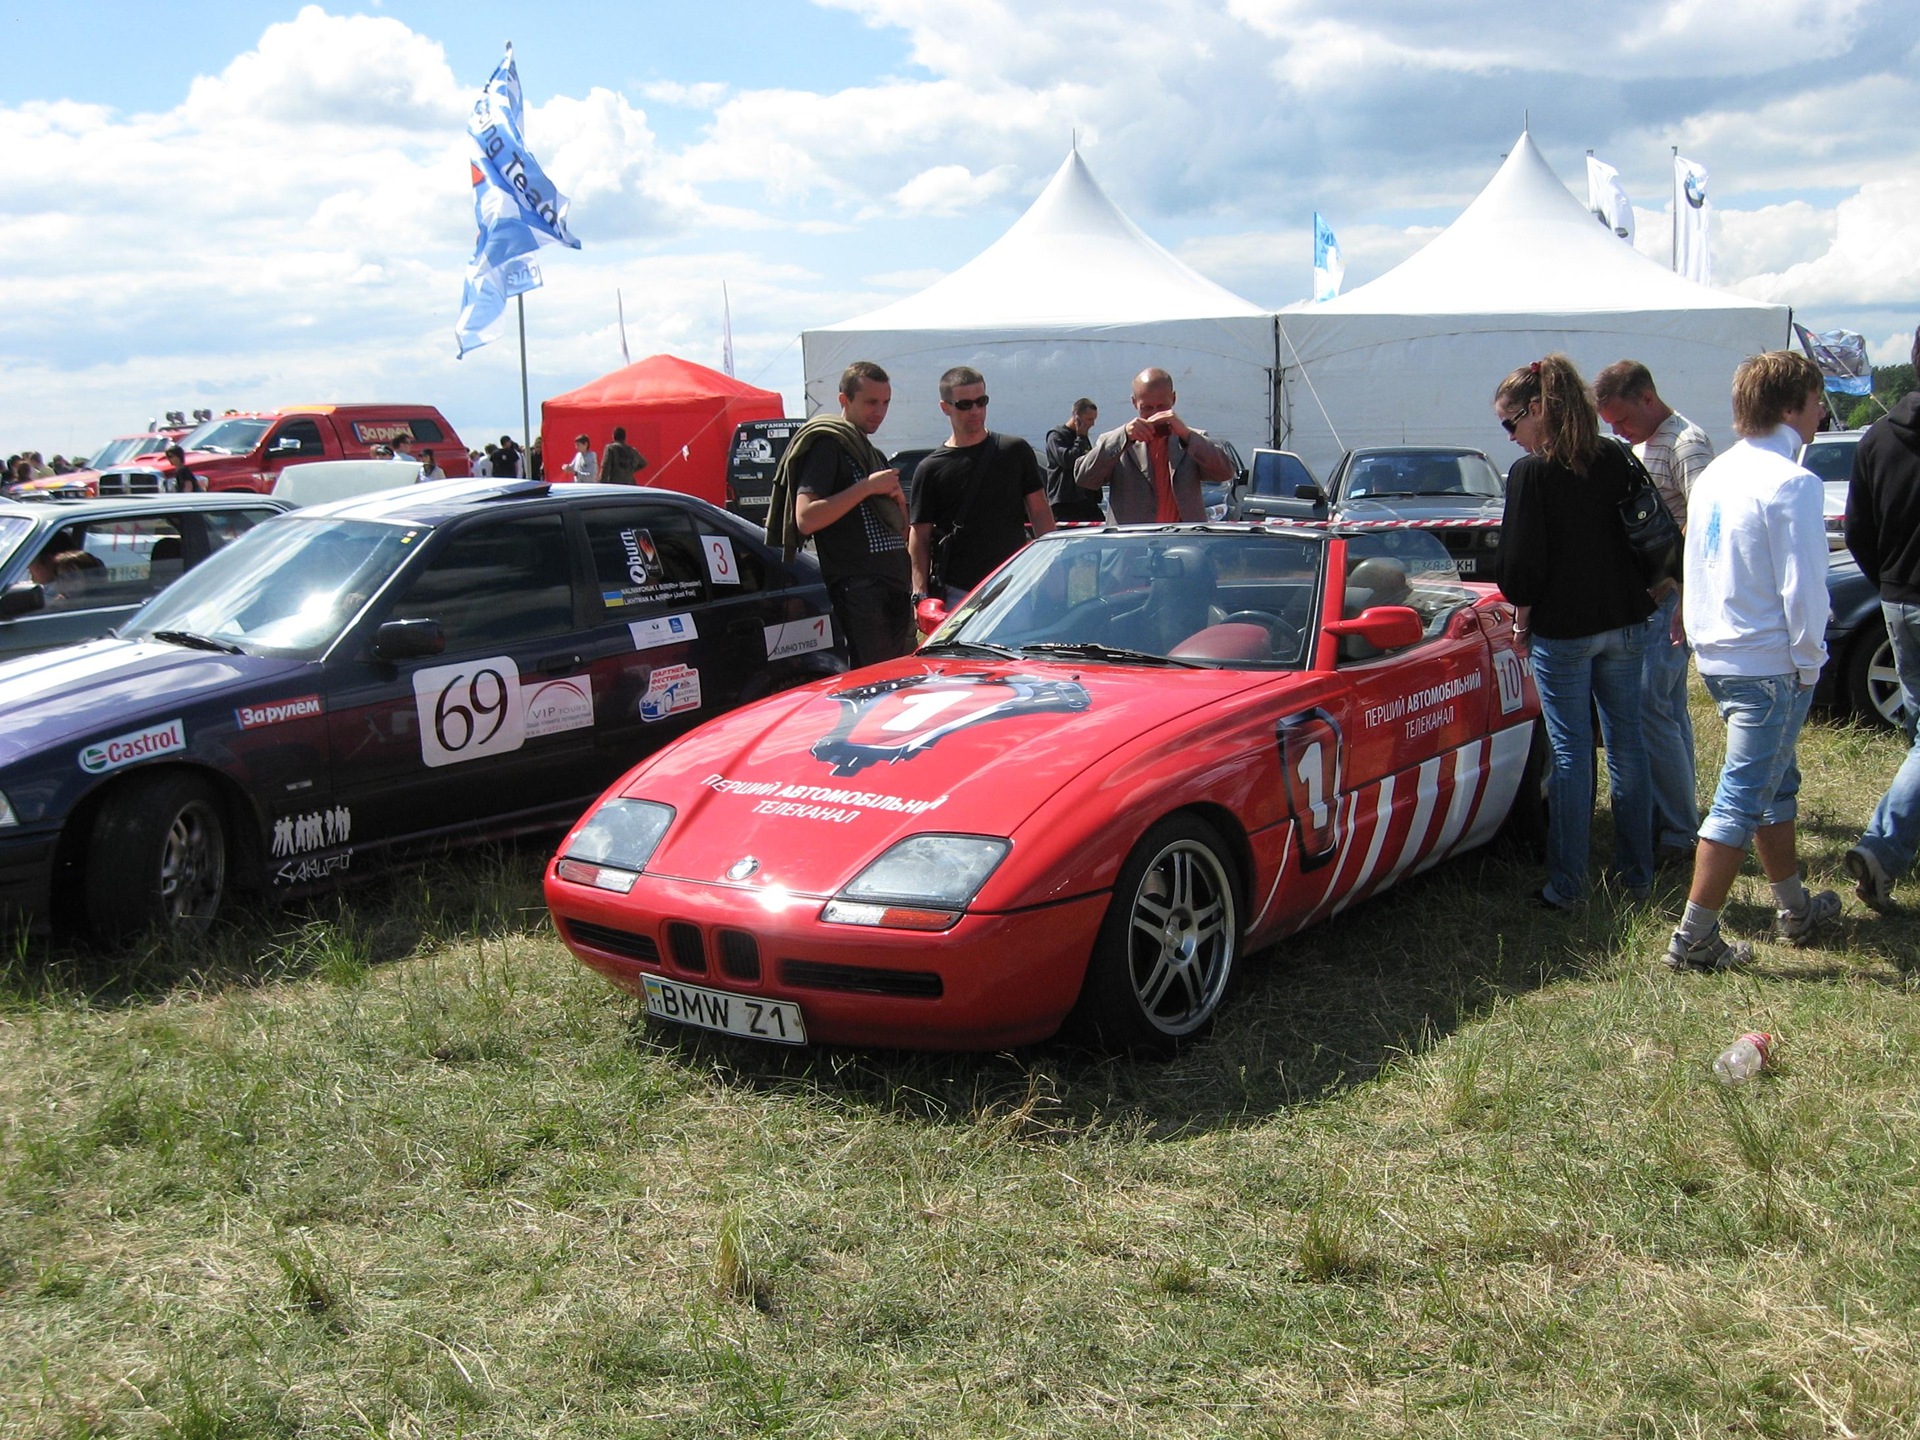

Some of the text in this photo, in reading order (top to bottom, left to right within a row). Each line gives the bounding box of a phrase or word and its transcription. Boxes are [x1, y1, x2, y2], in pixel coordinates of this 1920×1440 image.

[713, 542, 728, 575] 3
[1457, 560, 1473, 571] KH
[799, 638, 818, 650] TYRES
[652, 666, 685, 678] ПАРТНЕР
[1500, 659, 1520, 701] 10
[435, 669, 508, 752] 69
[532, 704, 587, 719] VIP TOURS
[881, 690, 973, 732] 1
[1365, 668, 1481, 728] ПЕРШИЙ АВТОМОБІЛЬНИЙ
[1405, 706, 1454, 739] ТЕЛЕКАНАЛ
[108, 726, 180, 763] Castrol
[701, 773, 949, 815] ПЕРШИЙ АВТОМОБІЛЬНИЙ
[1297, 741, 1328, 829] 1
[752, 800, 861, 824] ТЕЛЕКАНАЛ
[661, 985, 729, 1028] BMW
[745, 1002, 786, 1037] Z1
